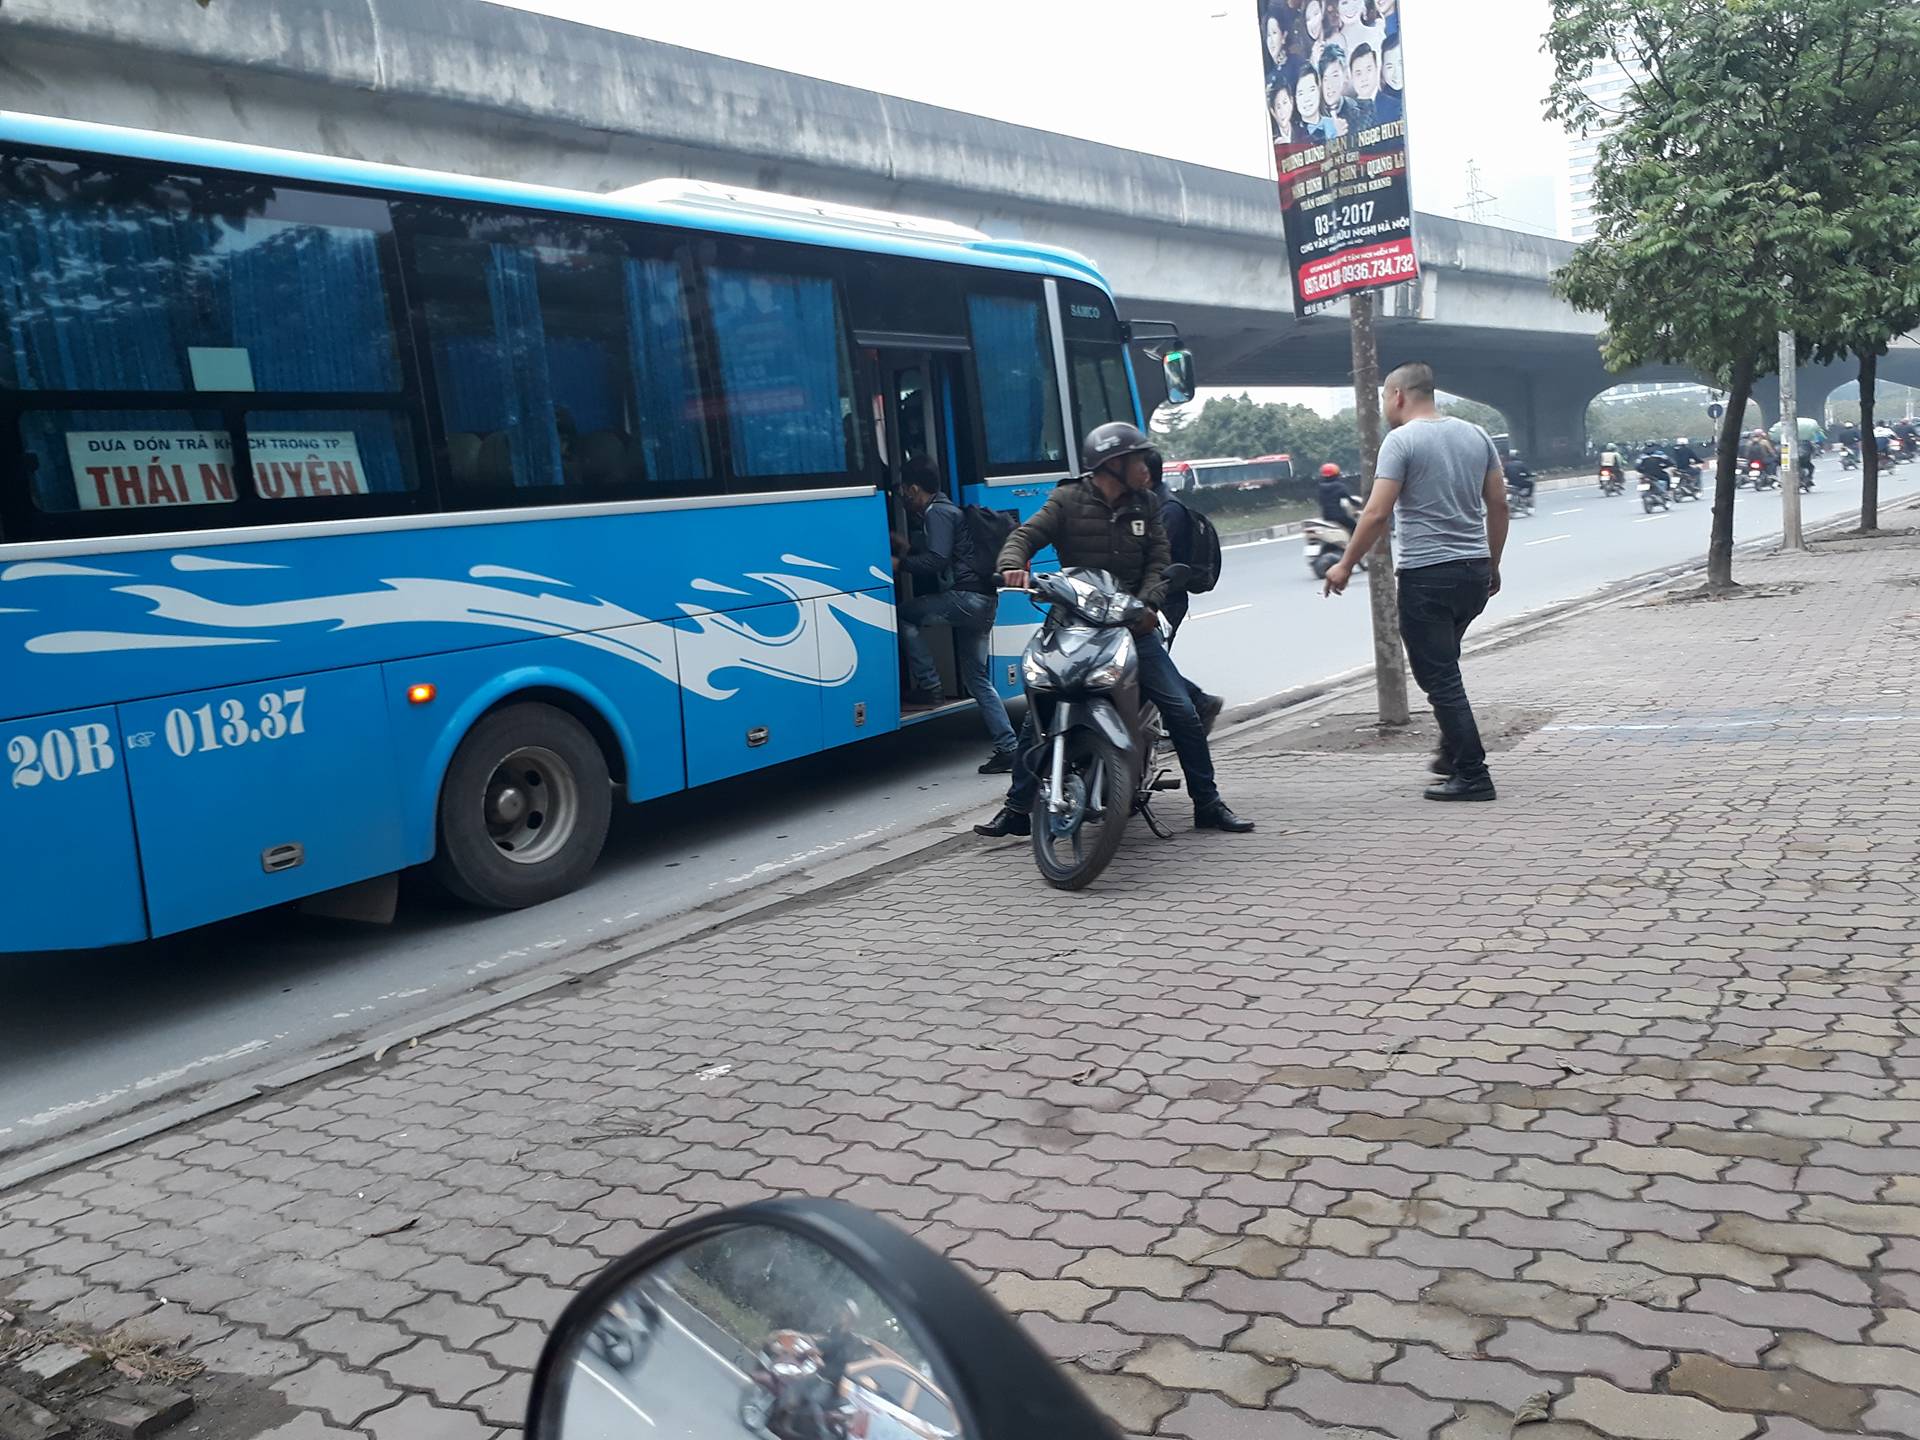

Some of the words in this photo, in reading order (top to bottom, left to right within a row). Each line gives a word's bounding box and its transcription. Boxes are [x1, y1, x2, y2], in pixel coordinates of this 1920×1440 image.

[1366, 155, 1393, 179] QUANG
[1352, 225, 1378, 238] NGHỊ
[1378, 219, 1392, 233] HÀ
[1392, 215, 1411, 231] NỘI
[88, 438, 126, 451] ĐƯA
[133, 436, 171, 451] ĐÓN
[176, 434, 209, 450] TRẢ
[214, 438, 266, 450] KHCH
[270, 438, 320, 450] TRONG
[323, 438, 341, 449] TP
[86, 456, 190, 506] THÁI
[198, 453, 359, 501] NUYÊN
[7, 722, 115, 789] 20B
[164, 686, 307, 758] 013.37
